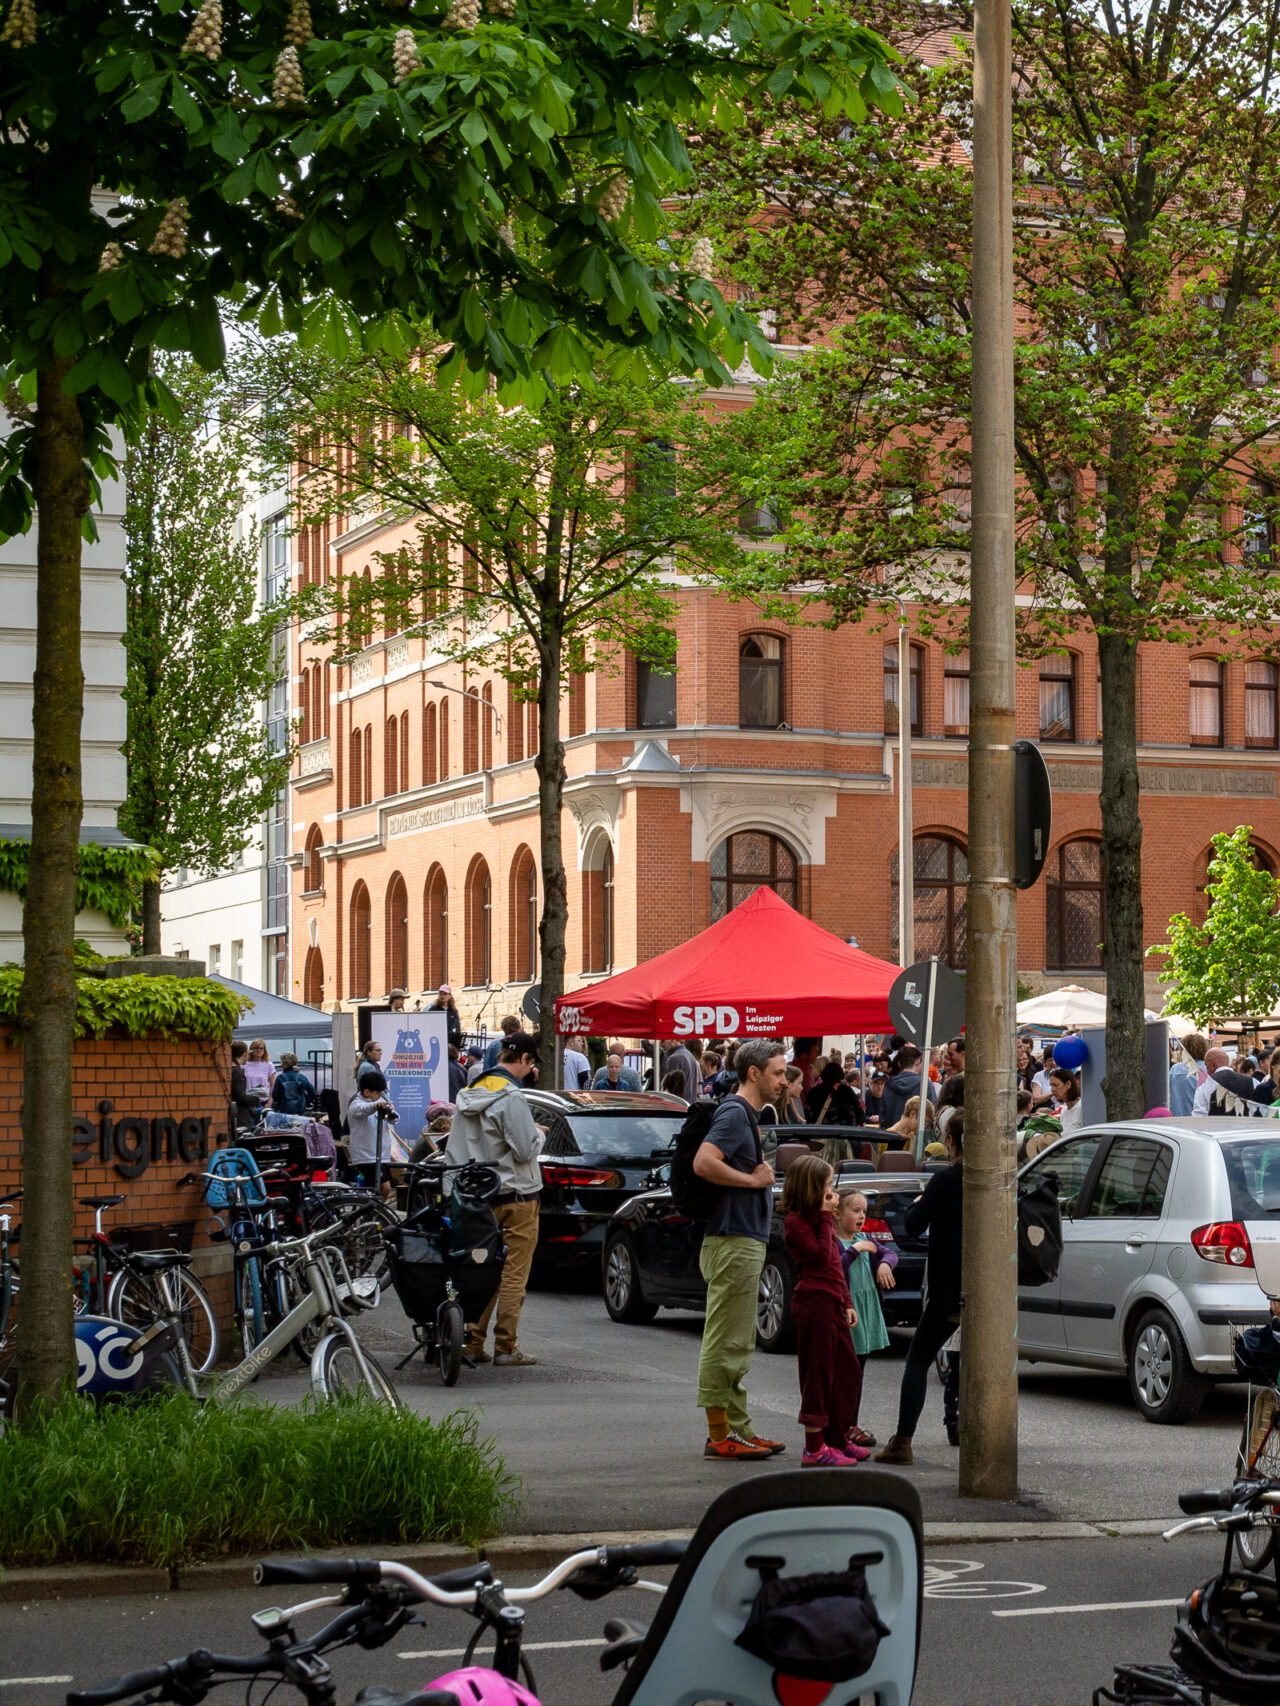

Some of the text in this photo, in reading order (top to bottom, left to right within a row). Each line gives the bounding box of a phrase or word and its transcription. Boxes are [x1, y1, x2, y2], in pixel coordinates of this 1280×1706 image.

[746, 1006, 757, 1014] Im
[673, 1006, 740, 1035] SPD
[746, 1015, 784, 1025] Leipziger
[746, 1024, 777, 1033] Westen
[216, 1345, 272, 1401] nextbike
